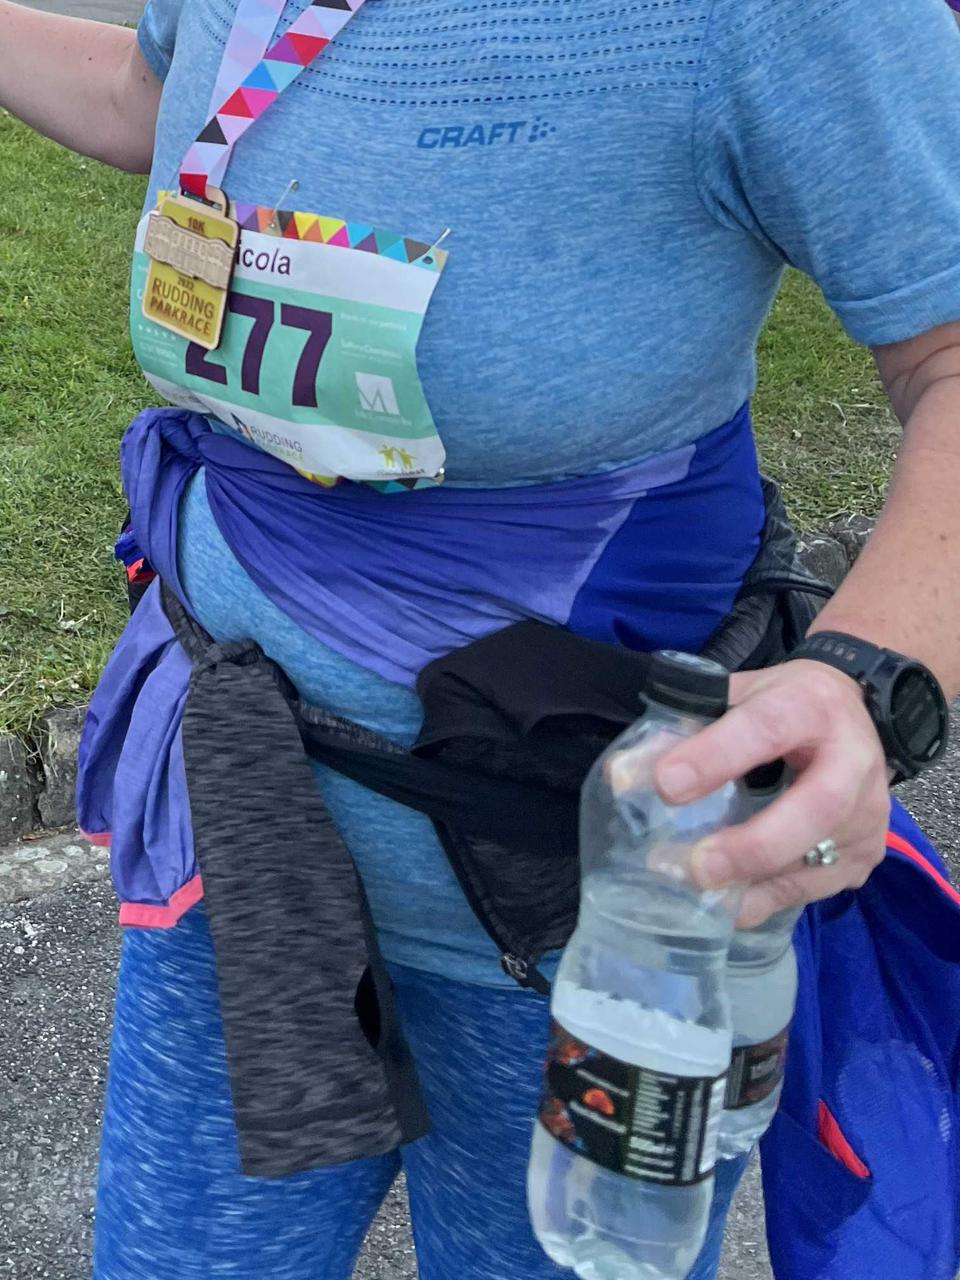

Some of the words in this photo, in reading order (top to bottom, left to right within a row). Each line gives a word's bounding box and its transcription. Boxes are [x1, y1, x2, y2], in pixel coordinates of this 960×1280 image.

[416, 120, 528, 150] CRAFT
[236, 238, 291, 276] icola
[149, 296, 212, 337] PARKRACE
[152, 277, 215, 320] RUDDING
